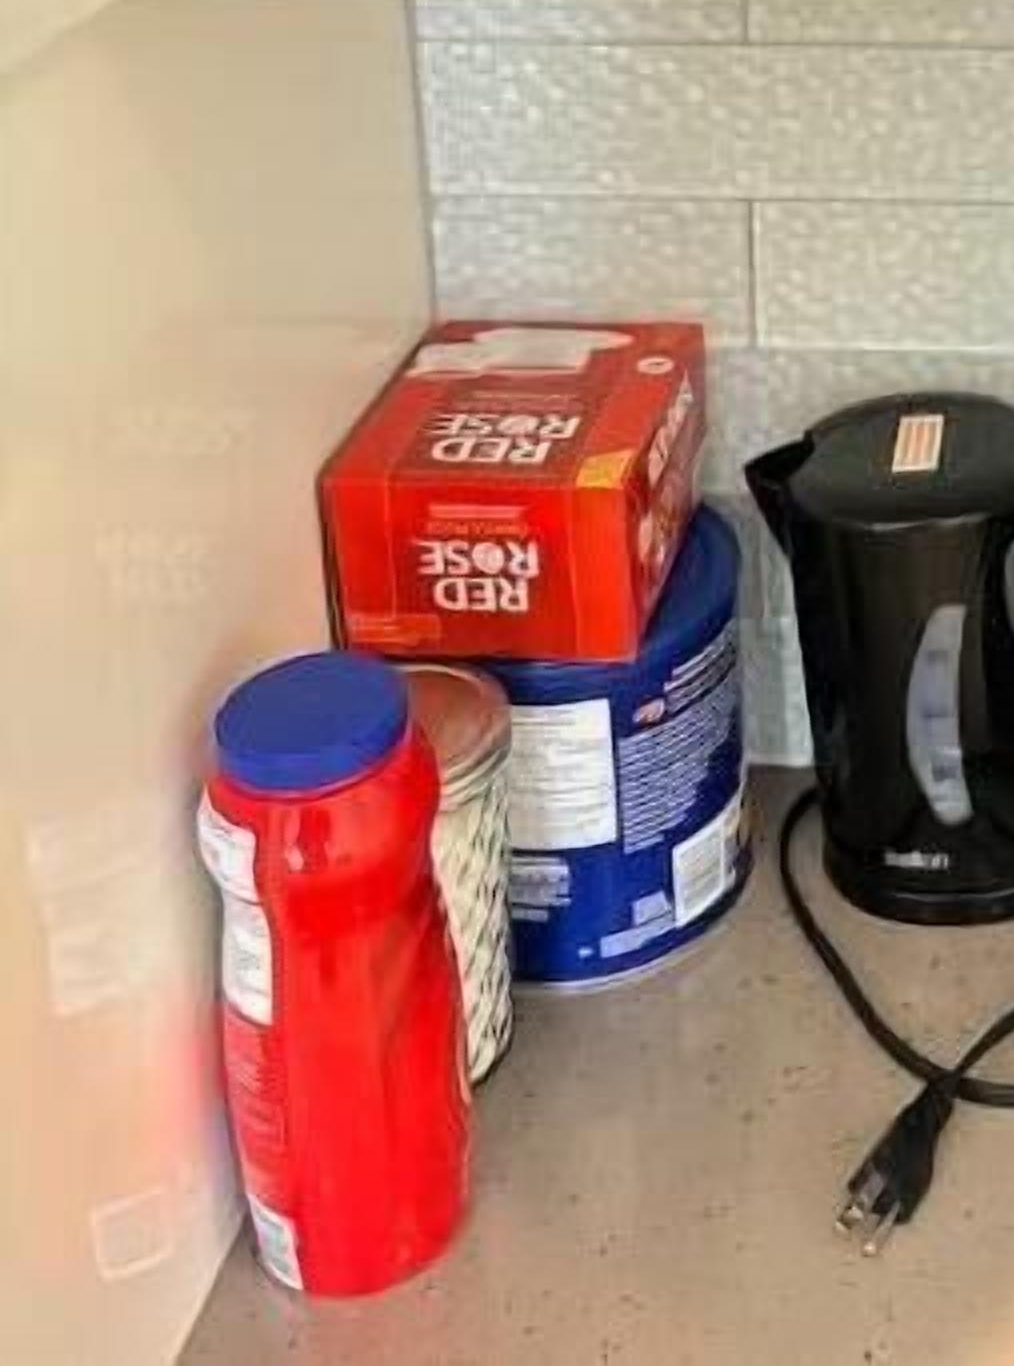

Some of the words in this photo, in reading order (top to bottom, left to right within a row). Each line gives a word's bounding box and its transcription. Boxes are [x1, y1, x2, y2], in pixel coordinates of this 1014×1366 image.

[425, 414, 580, 439] ROSE
[431, 437, 551, 464] RED
[414, 539, 540, 577] ROSE
[434, 578, 529, 612] RED
